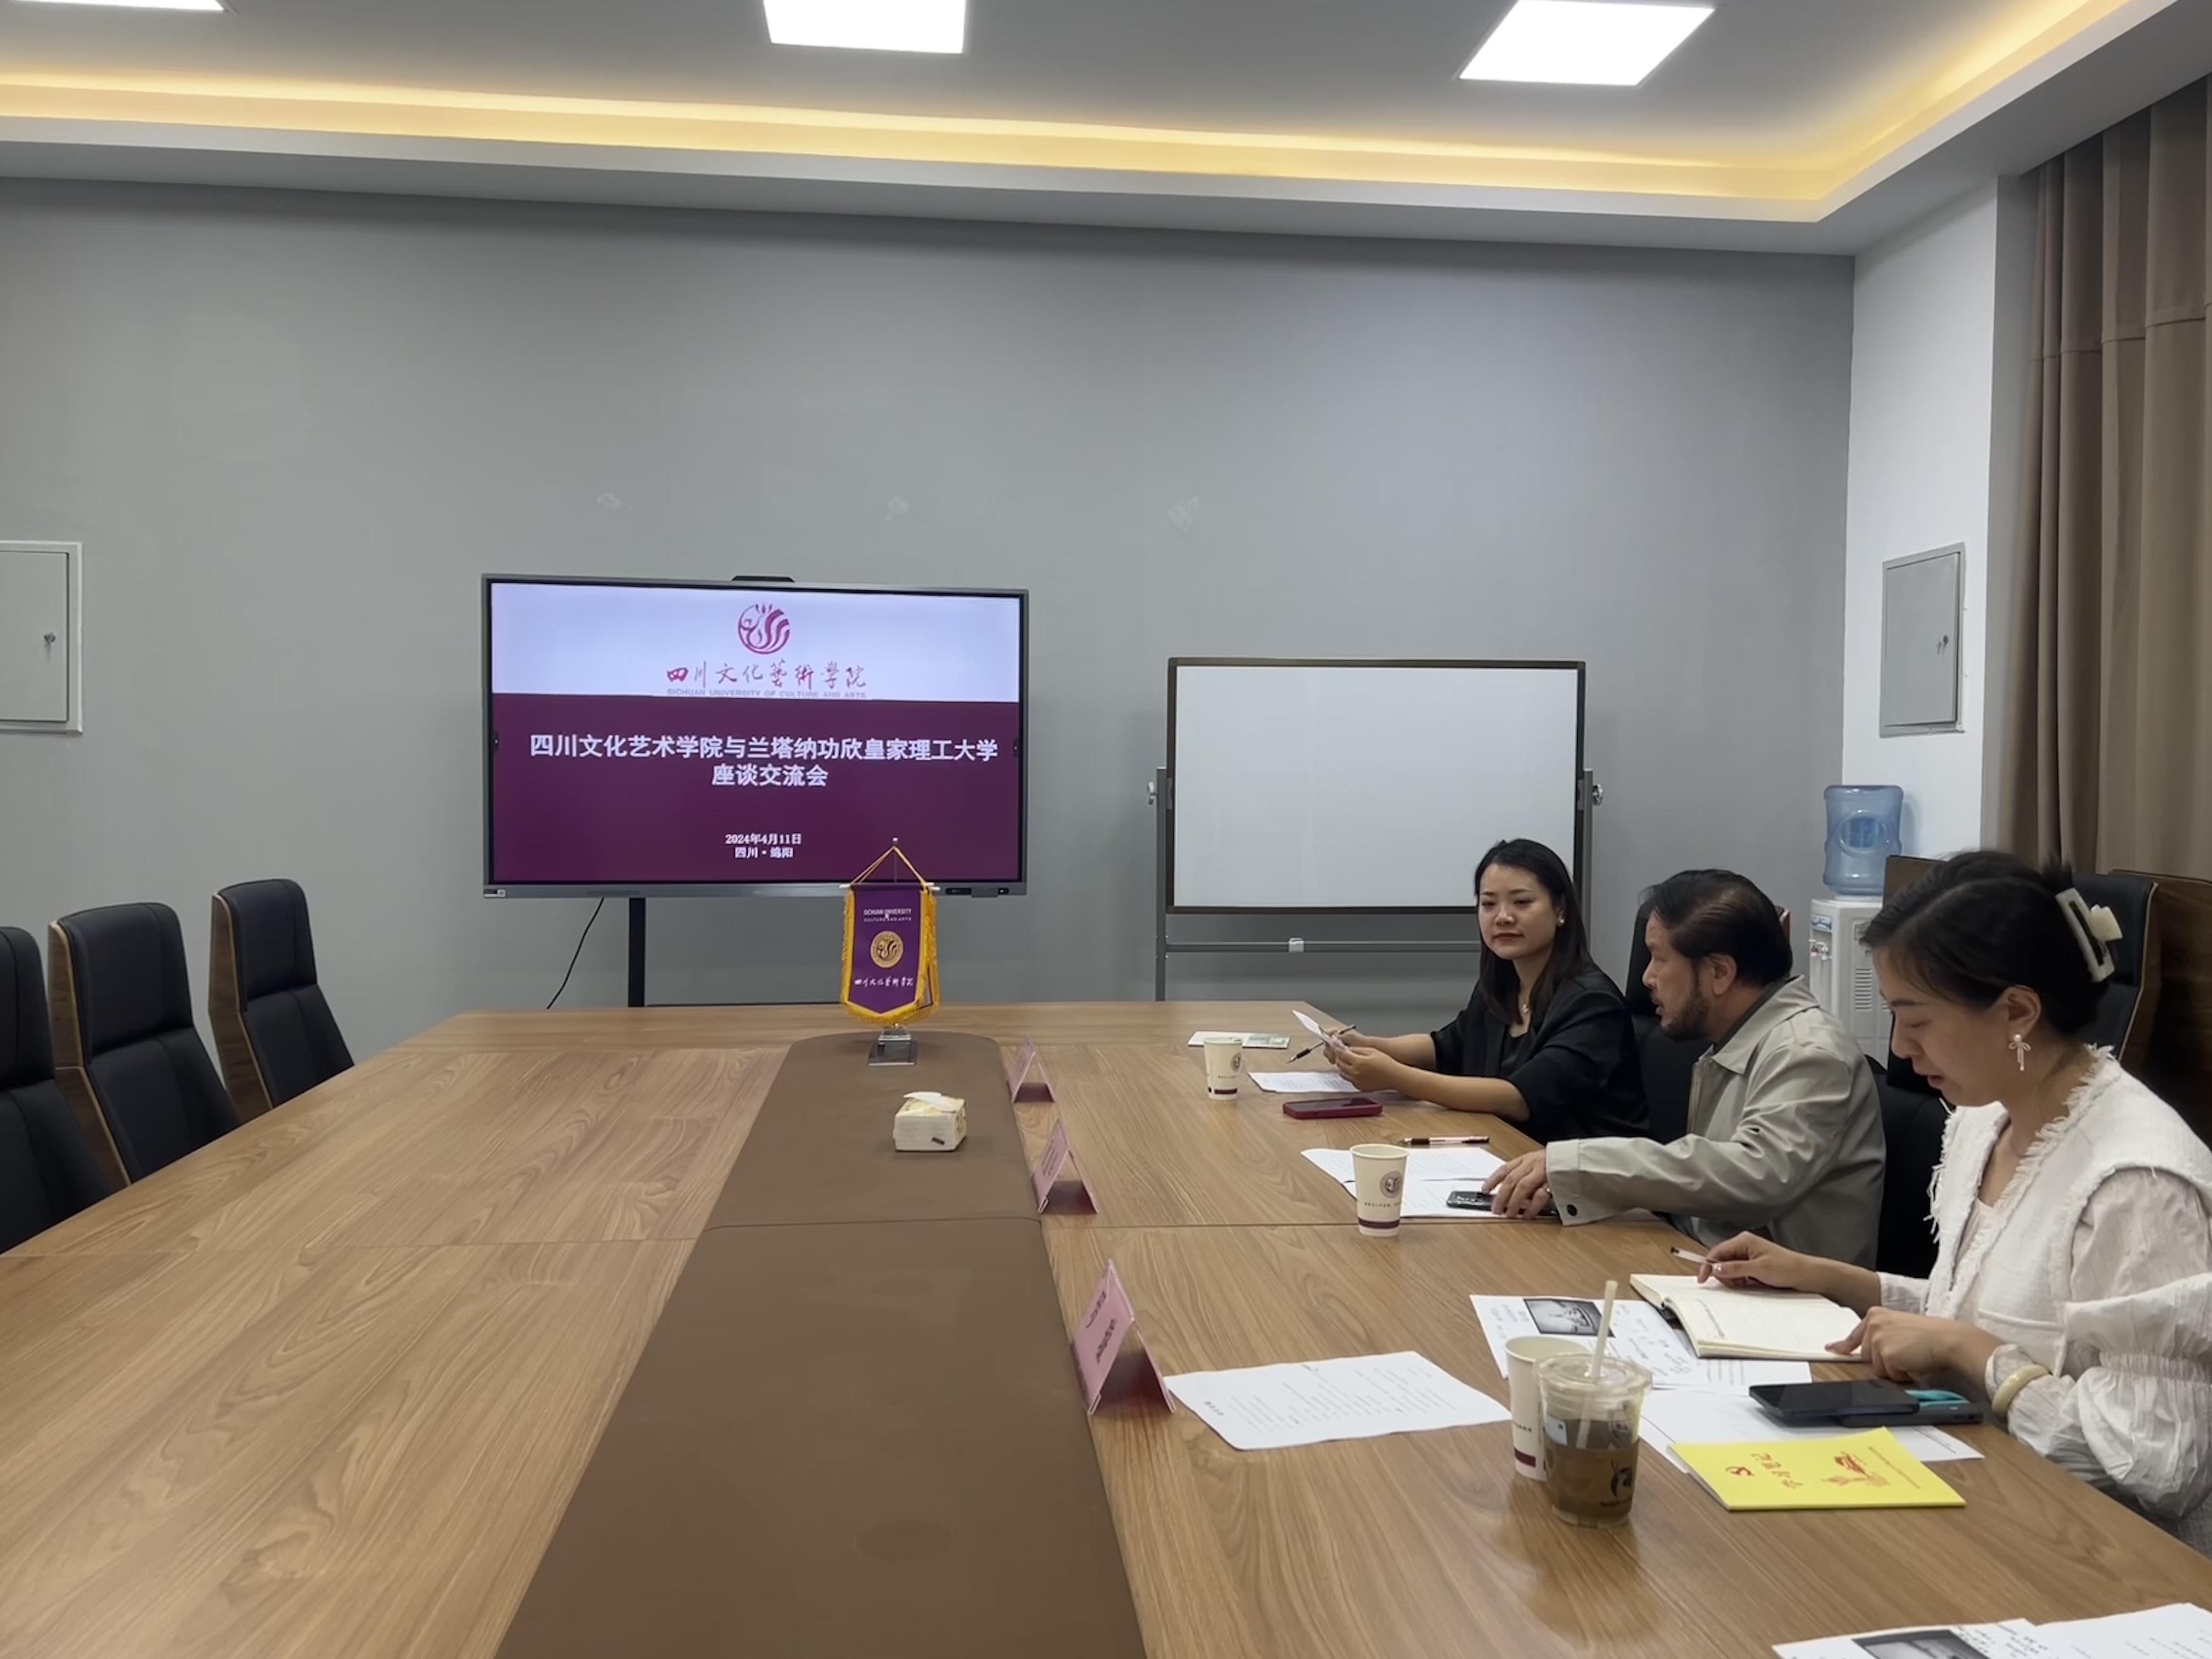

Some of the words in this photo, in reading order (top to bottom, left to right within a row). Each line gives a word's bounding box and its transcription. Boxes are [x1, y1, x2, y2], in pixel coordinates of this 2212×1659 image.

[531, 734, 998, 761] 四川文化艺术学院与兰塔纳功欣皇家理工大学
[712, 762, 829, 786] 座谈交流会
[725, 833, 802, 845] 2024年4月11日
